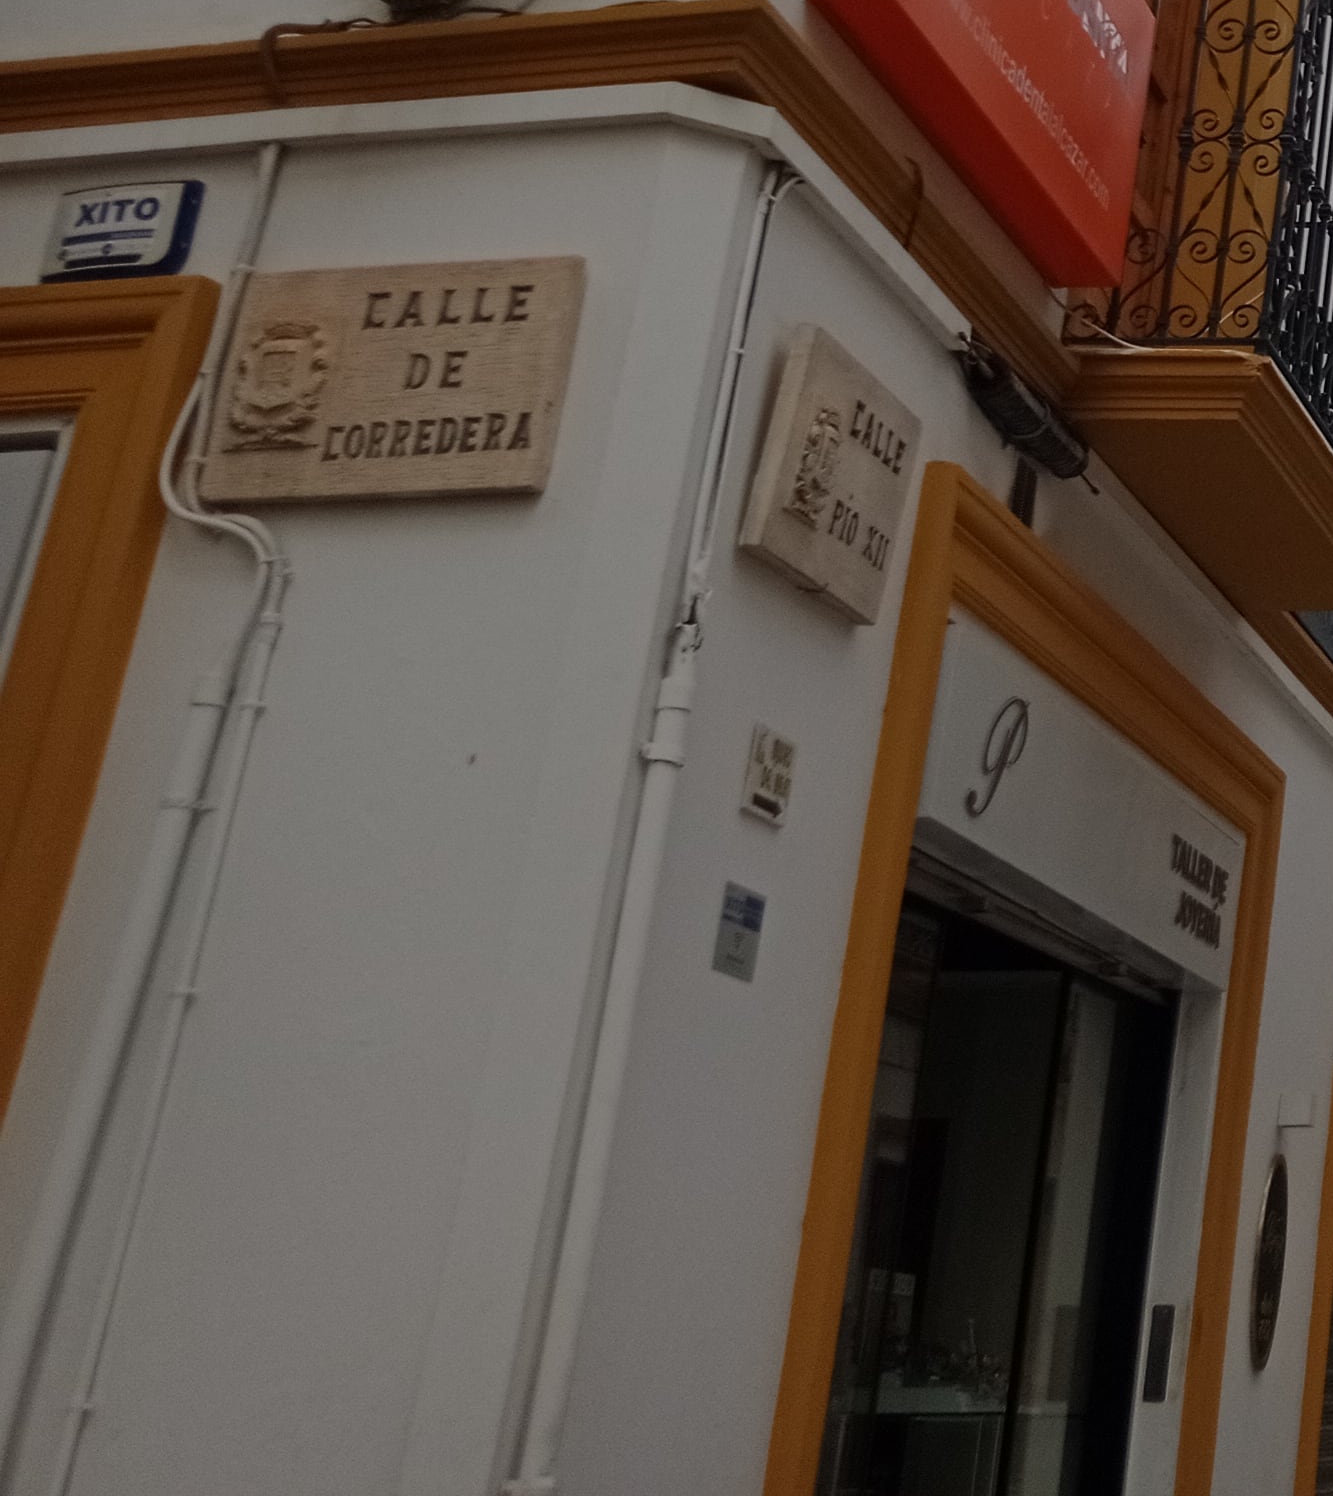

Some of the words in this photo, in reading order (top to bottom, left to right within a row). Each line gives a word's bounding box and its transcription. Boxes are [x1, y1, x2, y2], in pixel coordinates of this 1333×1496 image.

[362, 285, 534, 330] CALLE
[404, 350, 469, 390] DE
[321, 412, 533, 462] CORREDERA
[850, 399, 907, 476] CALLE
[828, 493, 860, 546] PÍO
[862, 525, 890, 571] XII
[1171, 833, 1213, 894] TALLER
